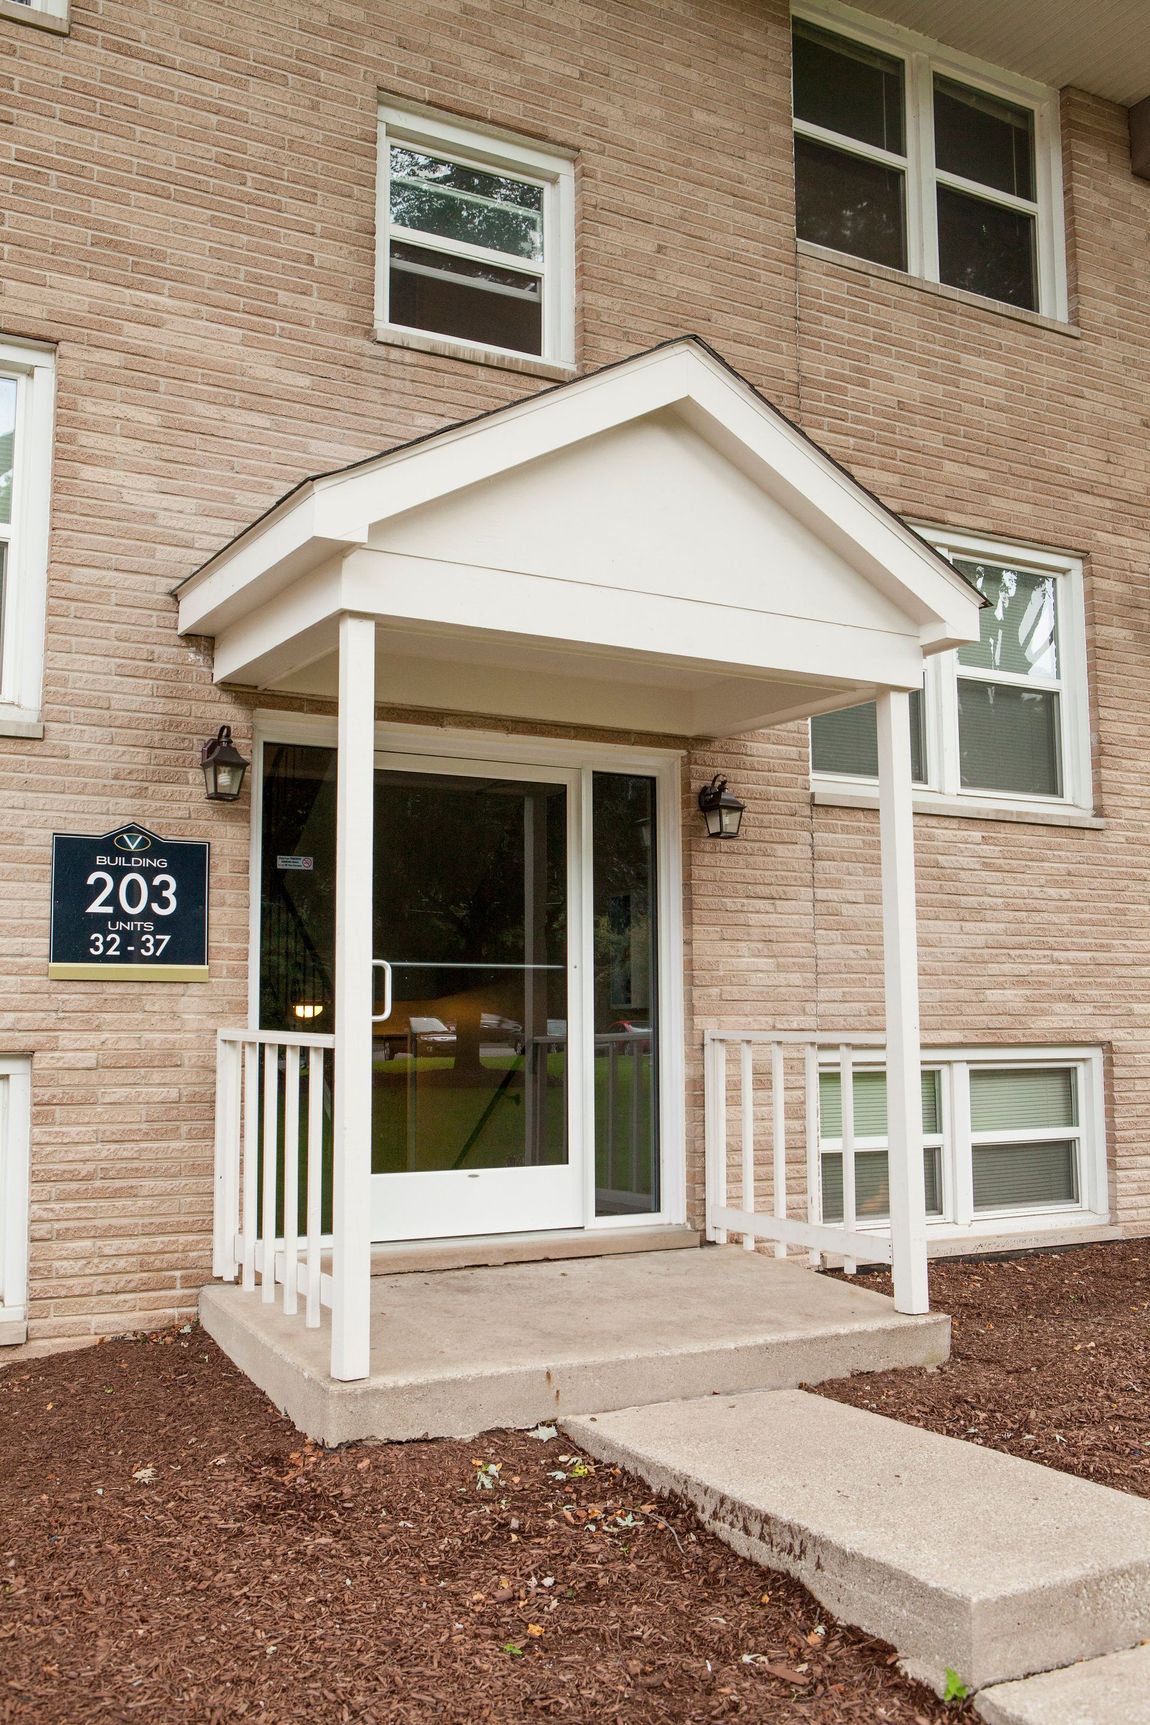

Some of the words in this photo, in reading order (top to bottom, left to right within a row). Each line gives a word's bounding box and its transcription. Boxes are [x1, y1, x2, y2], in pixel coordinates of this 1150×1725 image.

[122, 835, 143, 850] V
[96, 856, 168, 868] BUILDING
[85, 871, 177, 915] 203
[108, 921, 154, 931] UNITS
[89, 933, 120, 955] 32
[140, 934, 172, 957] 37
